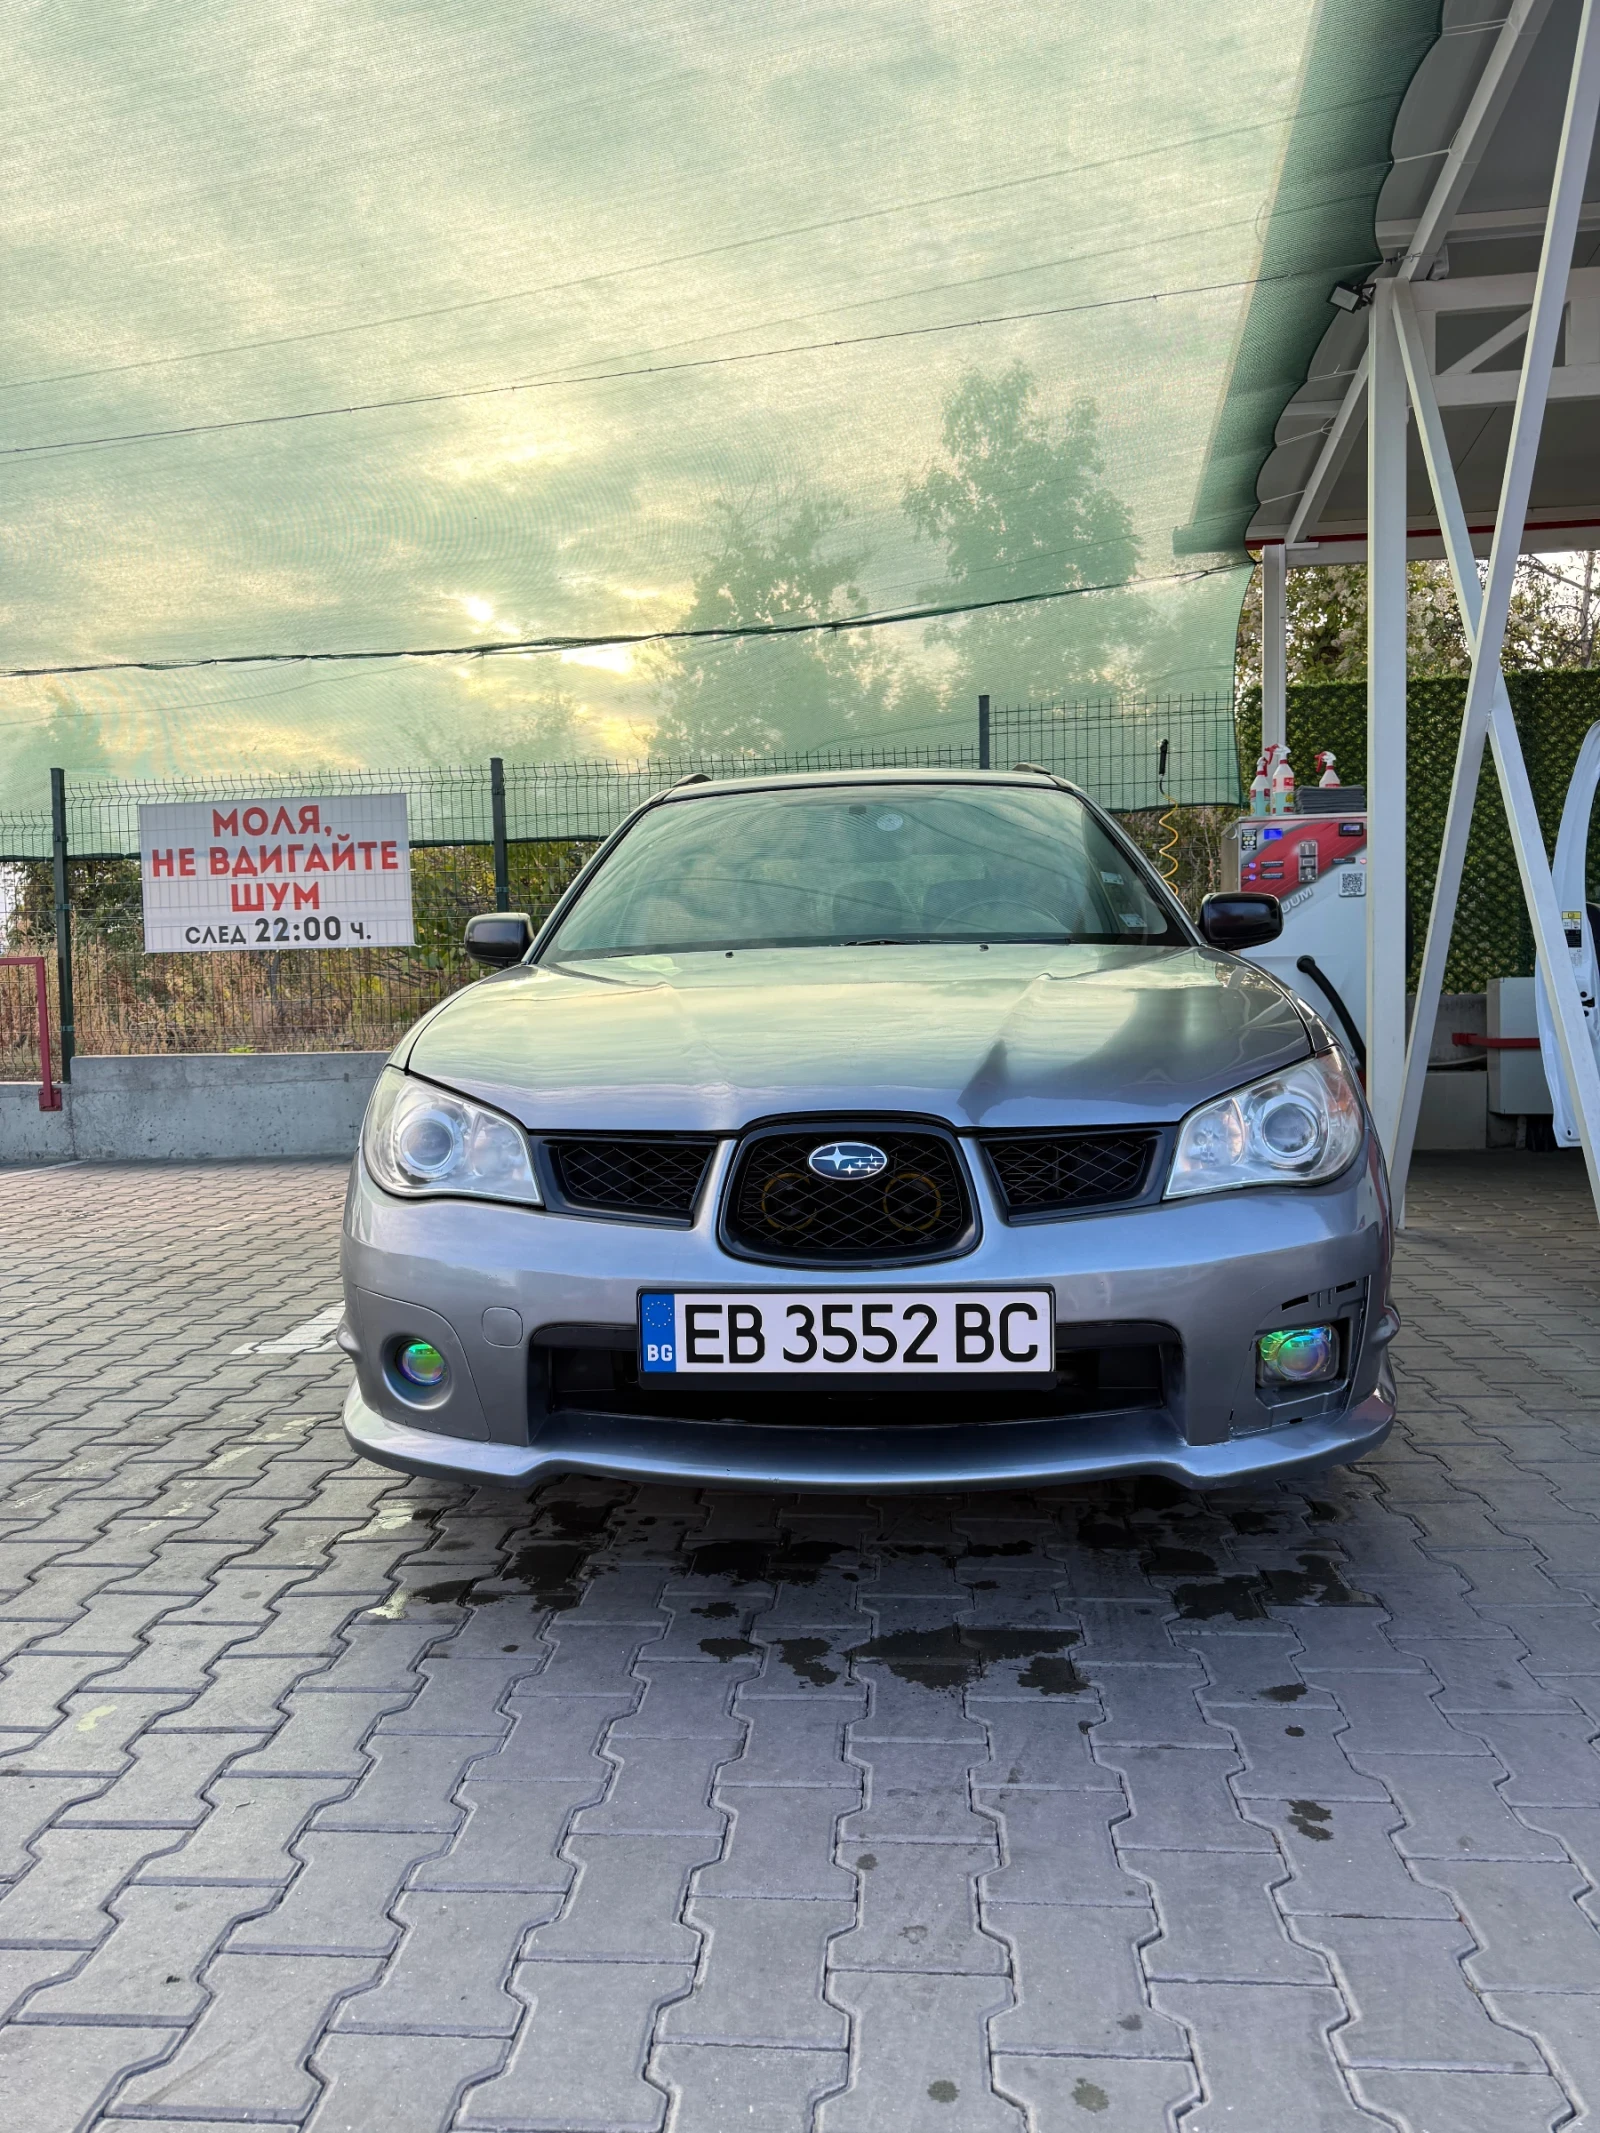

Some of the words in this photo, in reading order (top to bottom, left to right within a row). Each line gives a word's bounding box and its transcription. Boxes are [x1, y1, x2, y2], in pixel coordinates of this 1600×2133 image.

[212, 804, 333, 837] МОЛЯ,
[152, 847, 196, 877] НЕ
[209, 833, 399, 877] ВДИГАЙТЕ
[230, 881, 320, 912] ШУМ
[185, 925, 247, 944] СЛЕД
[254, 916, 341, 942] 22:00
[684, 1304, 765, 1363] EB
[782, 1304, 938, 1363] 3552
[955, 1303, 1039, 1363] BC
[647, 1344, 673, 1362] BG
